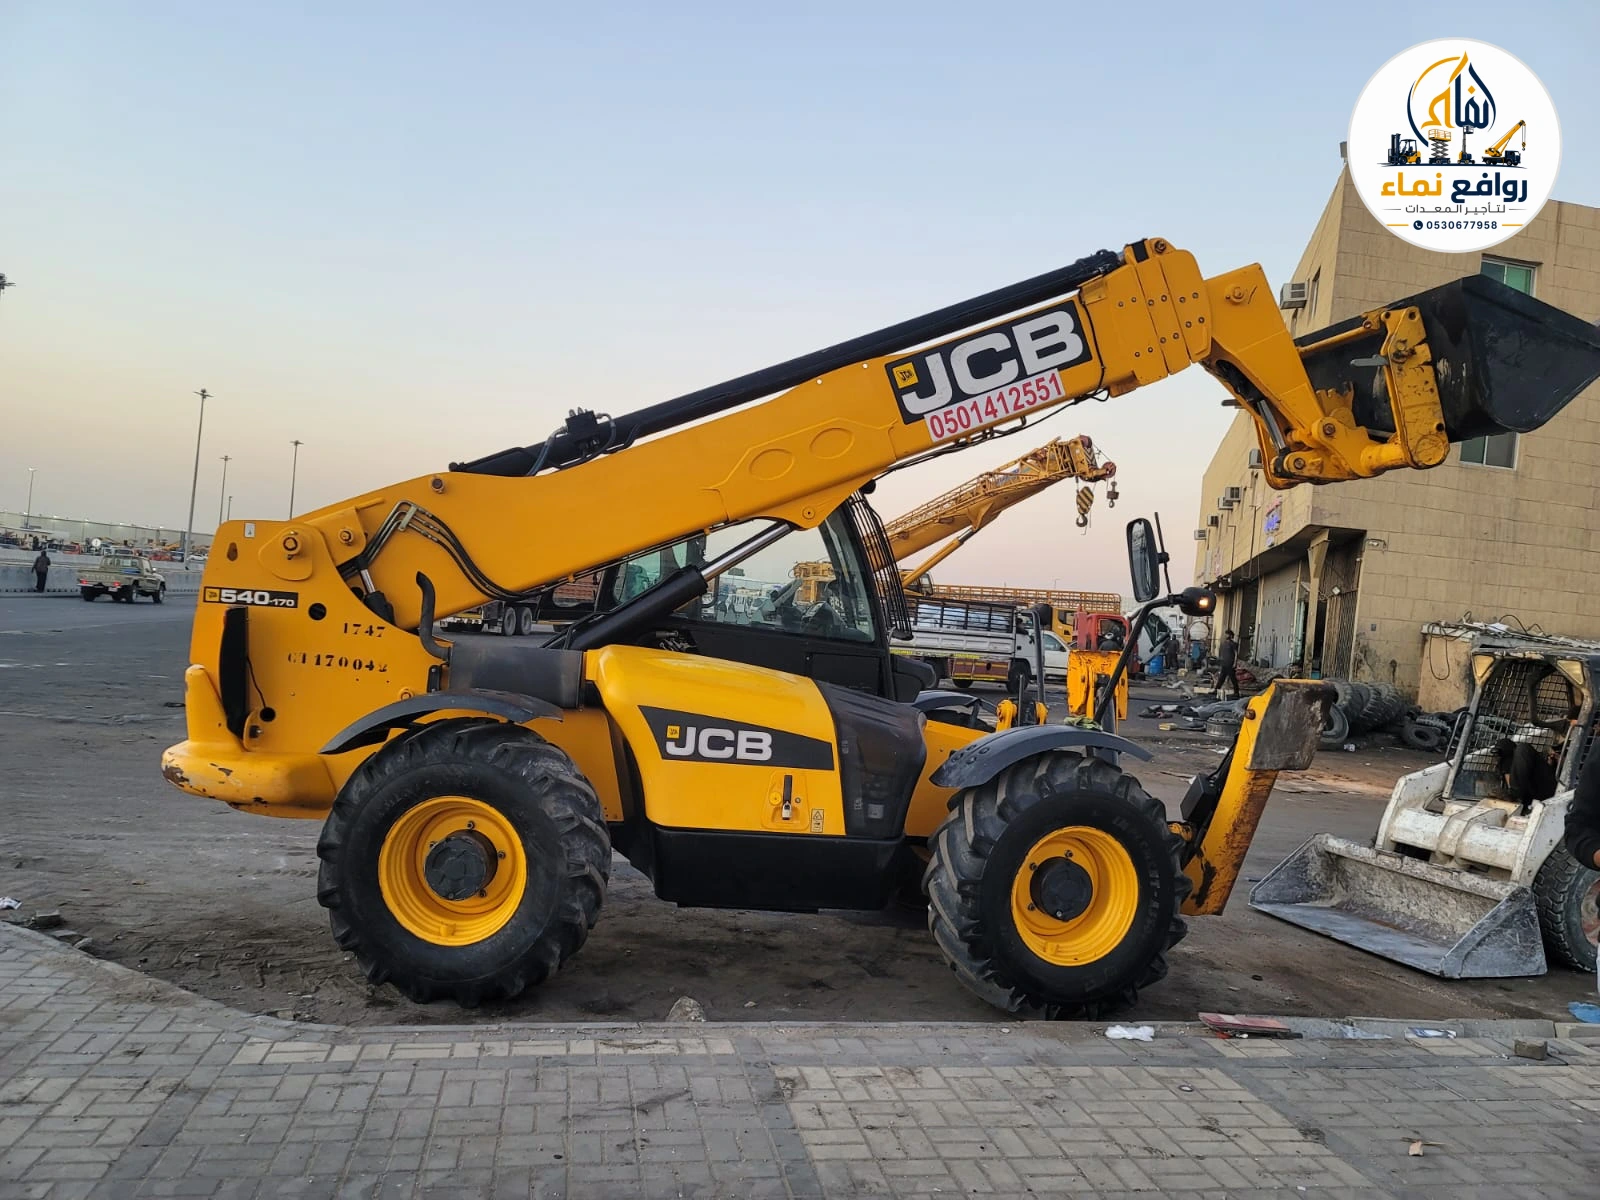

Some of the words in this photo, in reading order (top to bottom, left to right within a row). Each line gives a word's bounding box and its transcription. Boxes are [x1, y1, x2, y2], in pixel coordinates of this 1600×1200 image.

[901, 310, 1084, 415] JCB
[929, 372, 1063, 439] 0501412551
[220, 588, 295, 607] 540-170
[343, 622, 386, 638] 1747
[666, 726, 773, 761] JCB
